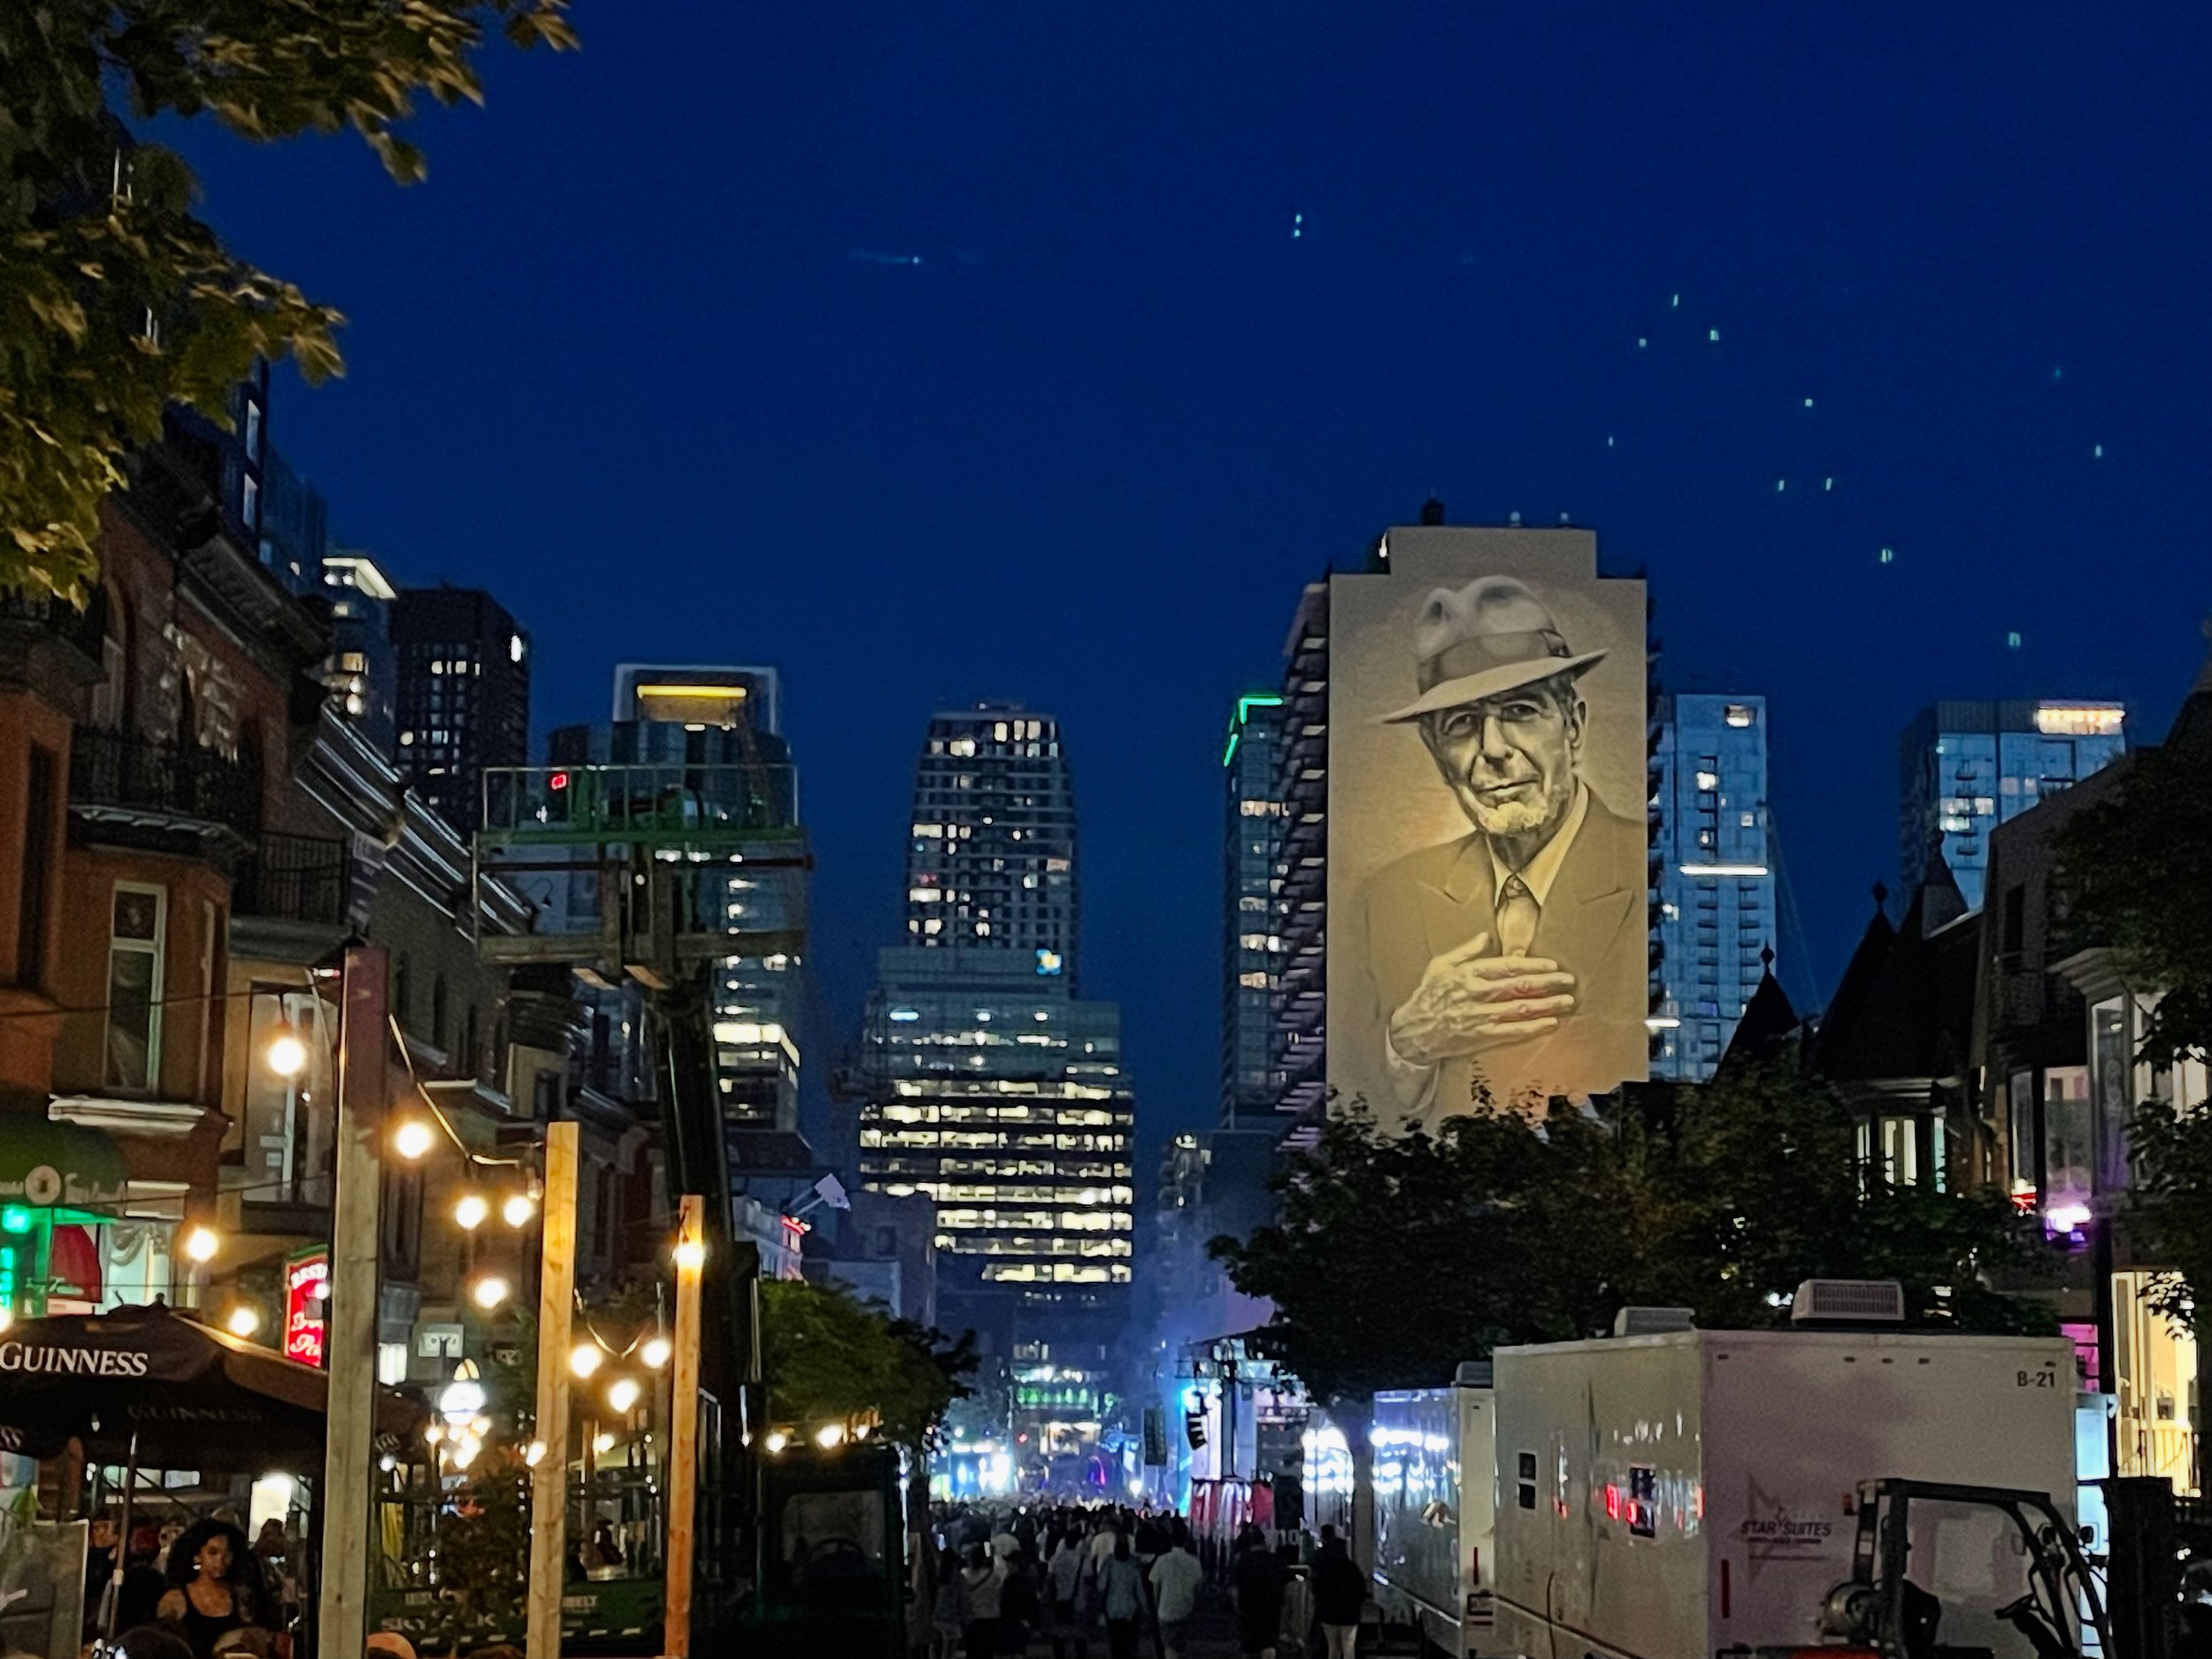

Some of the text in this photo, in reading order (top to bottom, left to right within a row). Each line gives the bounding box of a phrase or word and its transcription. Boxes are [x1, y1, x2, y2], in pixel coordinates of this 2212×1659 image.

[0, 1341, 148, 1376] GUINNESS
[2017, 1371, 2055, 1387] B-21
[1740, 1520, 1832, 1537] STAR SUITES
